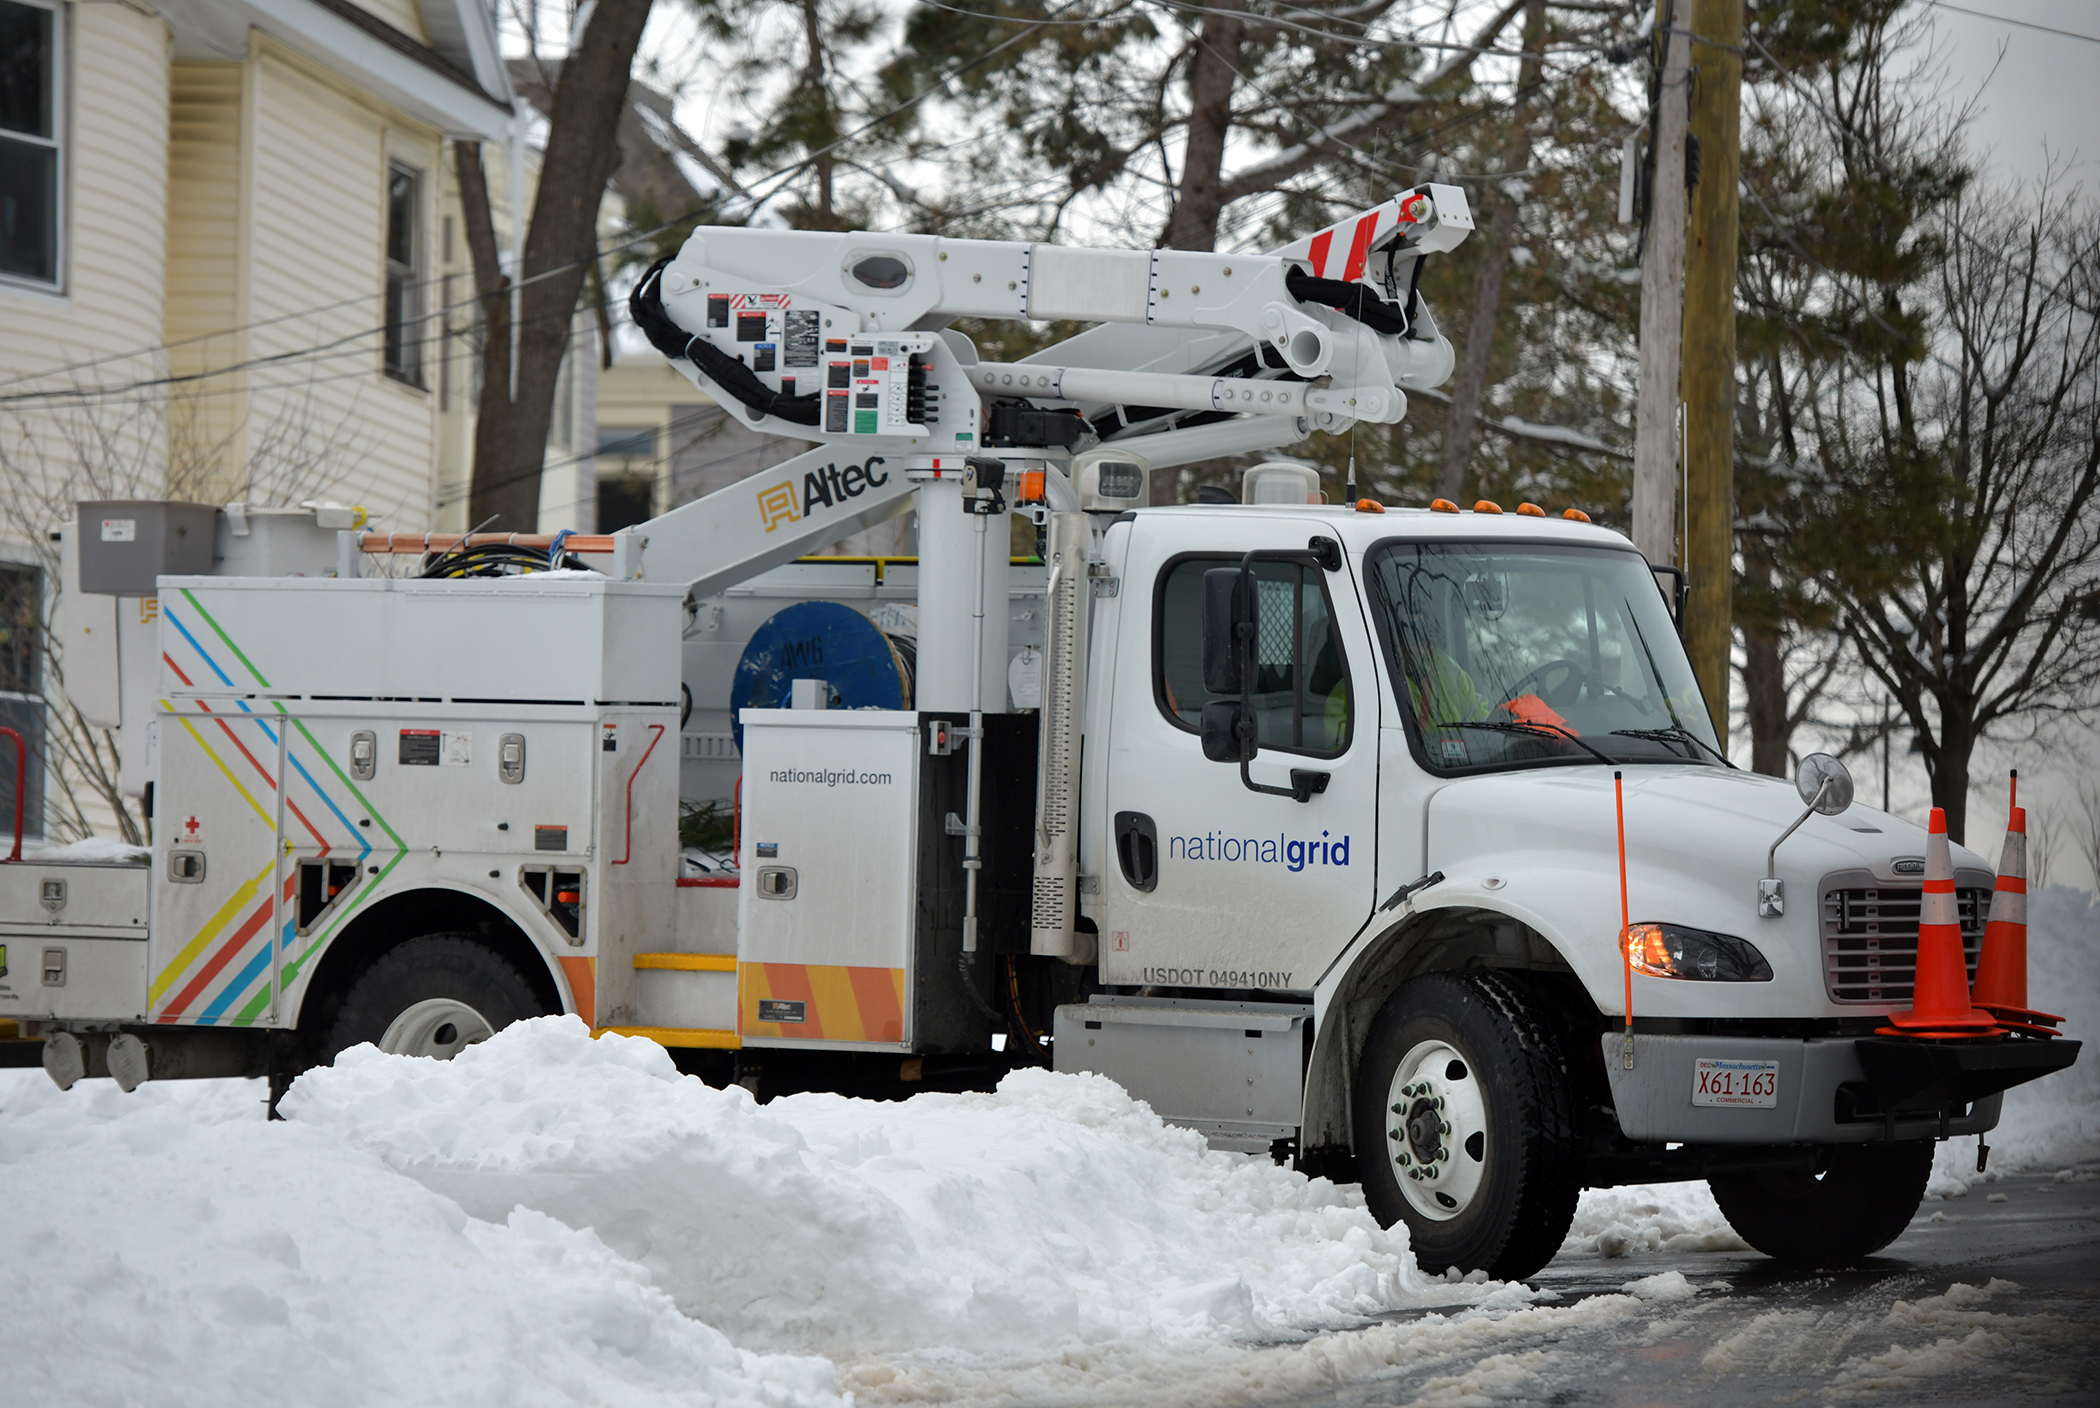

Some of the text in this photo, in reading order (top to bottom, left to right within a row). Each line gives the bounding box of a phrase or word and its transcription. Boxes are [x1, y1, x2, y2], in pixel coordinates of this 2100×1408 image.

[803, 456, 889, 518] Altec
[770, 768, 891, 787] nationalgrid.com
[1170, 830, 1350, 872] nationalgrid
[1144, 968, 1292, 988] USDOT 049410NY
[1716, 1061, 1762, 1070] Massachusetts
